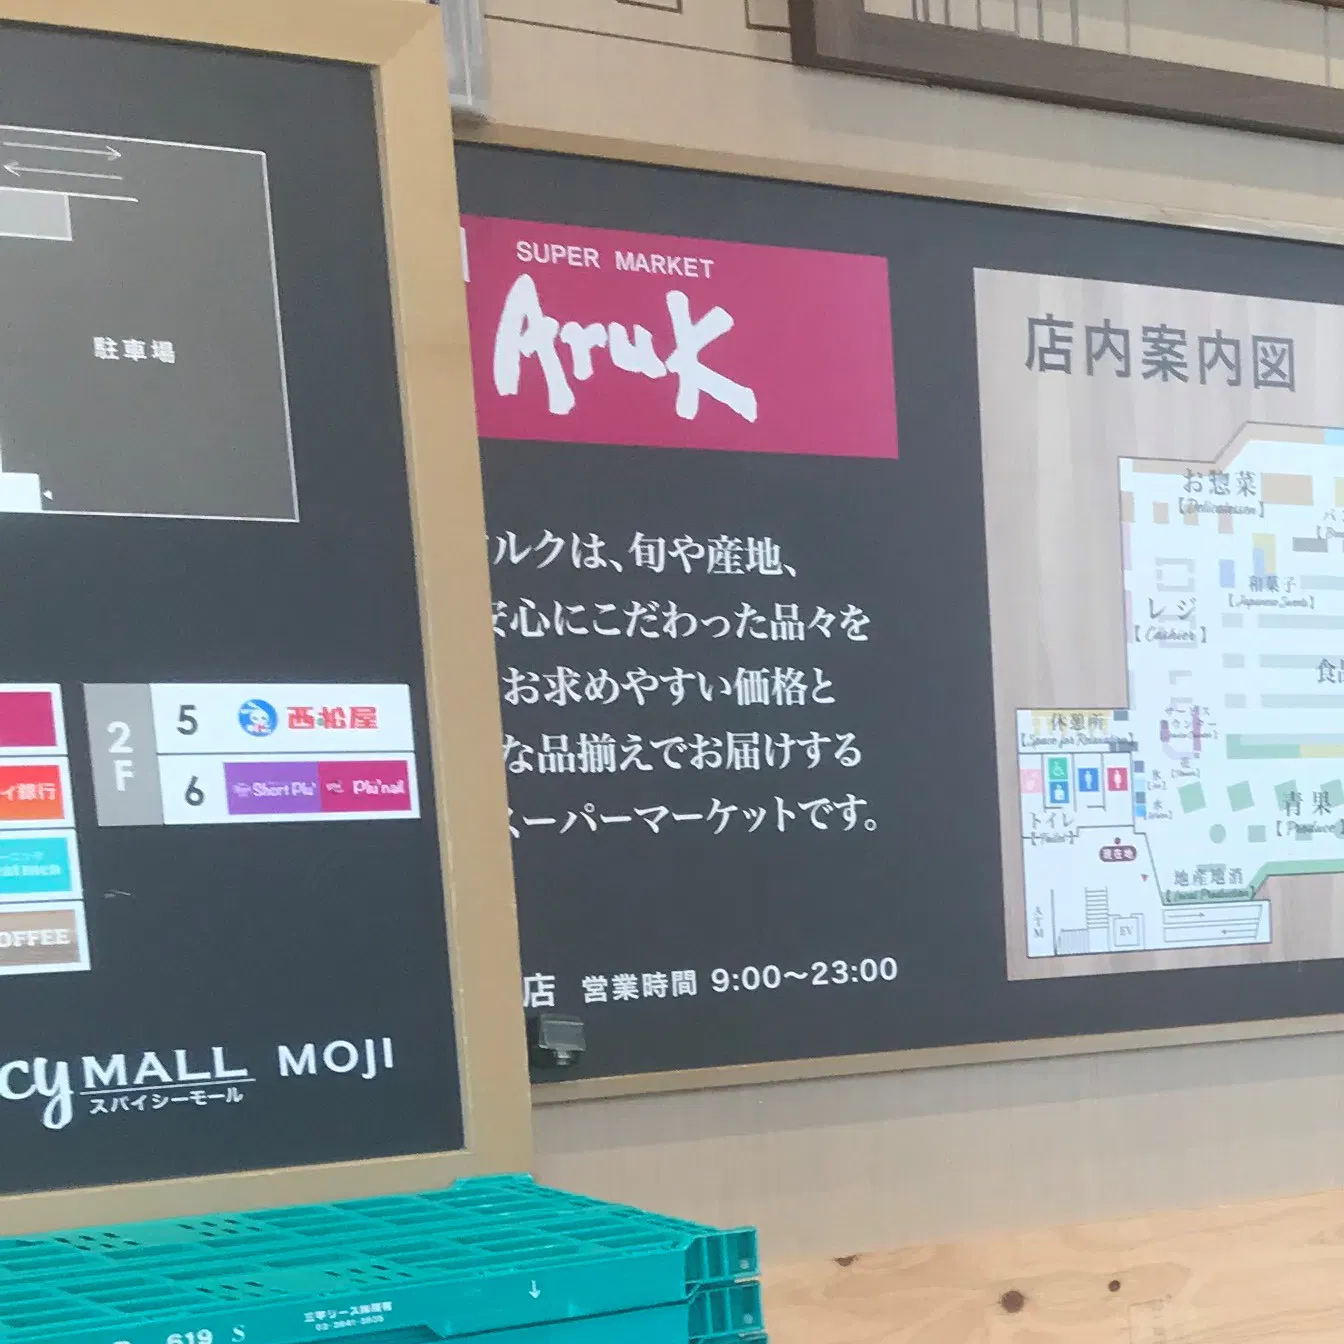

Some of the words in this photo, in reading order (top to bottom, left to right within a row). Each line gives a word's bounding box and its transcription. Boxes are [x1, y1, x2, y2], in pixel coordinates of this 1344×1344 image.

[516, 240, 600, 271] SUPER
[615, 250, 715, 281] MARKET
[93, 336, 177, 365] 駐車場
[1024, 312, 1299, 393] 店内案内図
[1182, 468, 1257, 497] お惣菜
[487, 530, 799, 578] ルクは、旬や産地、
[1147, 597, 1197, 620] レジ
[503, 666, 837, 706] お求めやすい価格と
[176, 704, 199, 736] 5
[286, 705, 379, 731] 西松屋
[502, 732, 863, 774] な品揃えでお届けする
[184, 775, 206, 807] 6
[1284, 790, 1333, 816] 青果
[522, 974, 556, 1008] 店
[582, 968, 698, 1003] 営業時間
[80, 1044, 250, 1089] MALL
[277, 1036, 395, 1080] MOJI
[88, 1087, 245, 1117] スパイシーモール
